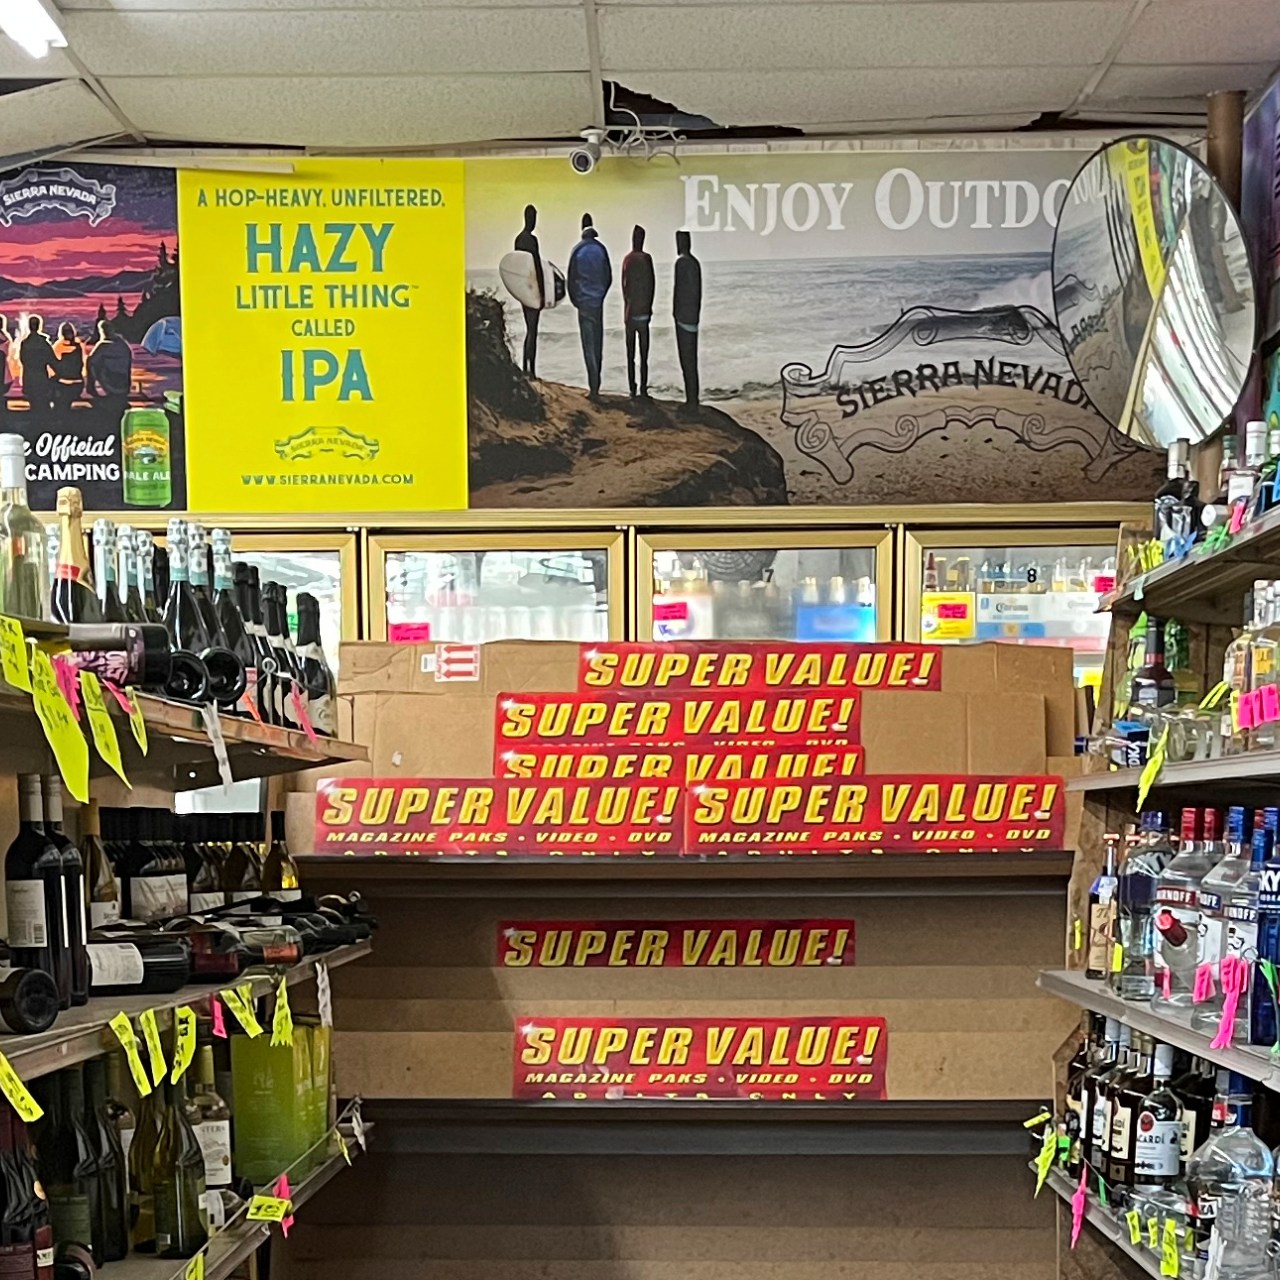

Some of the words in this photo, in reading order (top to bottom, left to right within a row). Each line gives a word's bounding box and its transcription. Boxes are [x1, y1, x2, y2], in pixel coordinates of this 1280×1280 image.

[2, 185, 48, 206] SIERRA
[49, 184, 96, 205] NEVADA
[197, 189, 208, 207] A
[680, 174, 855, 237] ENJOY
[245, 222, 395, 274] HAZY
[236, 284, 314, 309] LITTLE
[291, 318, 356, 337] CALLED
[280, 348, 376, 402] IPA
[834, 360, 962, 419] SIERRA
[35, 433, 116, 458] Official
[1026, 568, 1038, 583] 8
[584, 652, 754, 688] SUPER
[764, 651, 937, 687] VALUE!
[500, 698, 674, 738] SUPER
[683, 697, 856, 735] VALUE!
[322, 786, 495, 826] SUPER
[505, 785, 682, 825] VALUE!
[693, 784, 869, 825] SUPER
[880, 783, 1059, 823] VALUE!
[326, 831, 437, 843] MAGAZINE
[448, 831, 507, 843] PAKS
[535, 831, 599, 843] VIDEO
[627, 831, 672, 843] DVD
[698, 830, 811, 843] MAGAZINE
[822, 830, 883, 842] PAKS
[911, 829, 976, 841] VIDEO
[1005, 828, 1051, 841] DVD
[503, 929, 670, 967] SUPER
[681, 928, 850, 966] VALUE!
[520, 1026, 693, 1067] SUPER
[705, 1026, 881, 1066] VALUE!
[524, 1072, 637, 1084] MAGAZINE
[647, 1072, 708, 1084] PAKS
[734, 1072, 799, 1084] VIDEO
[827, 1072, 874, 1084] DVD
